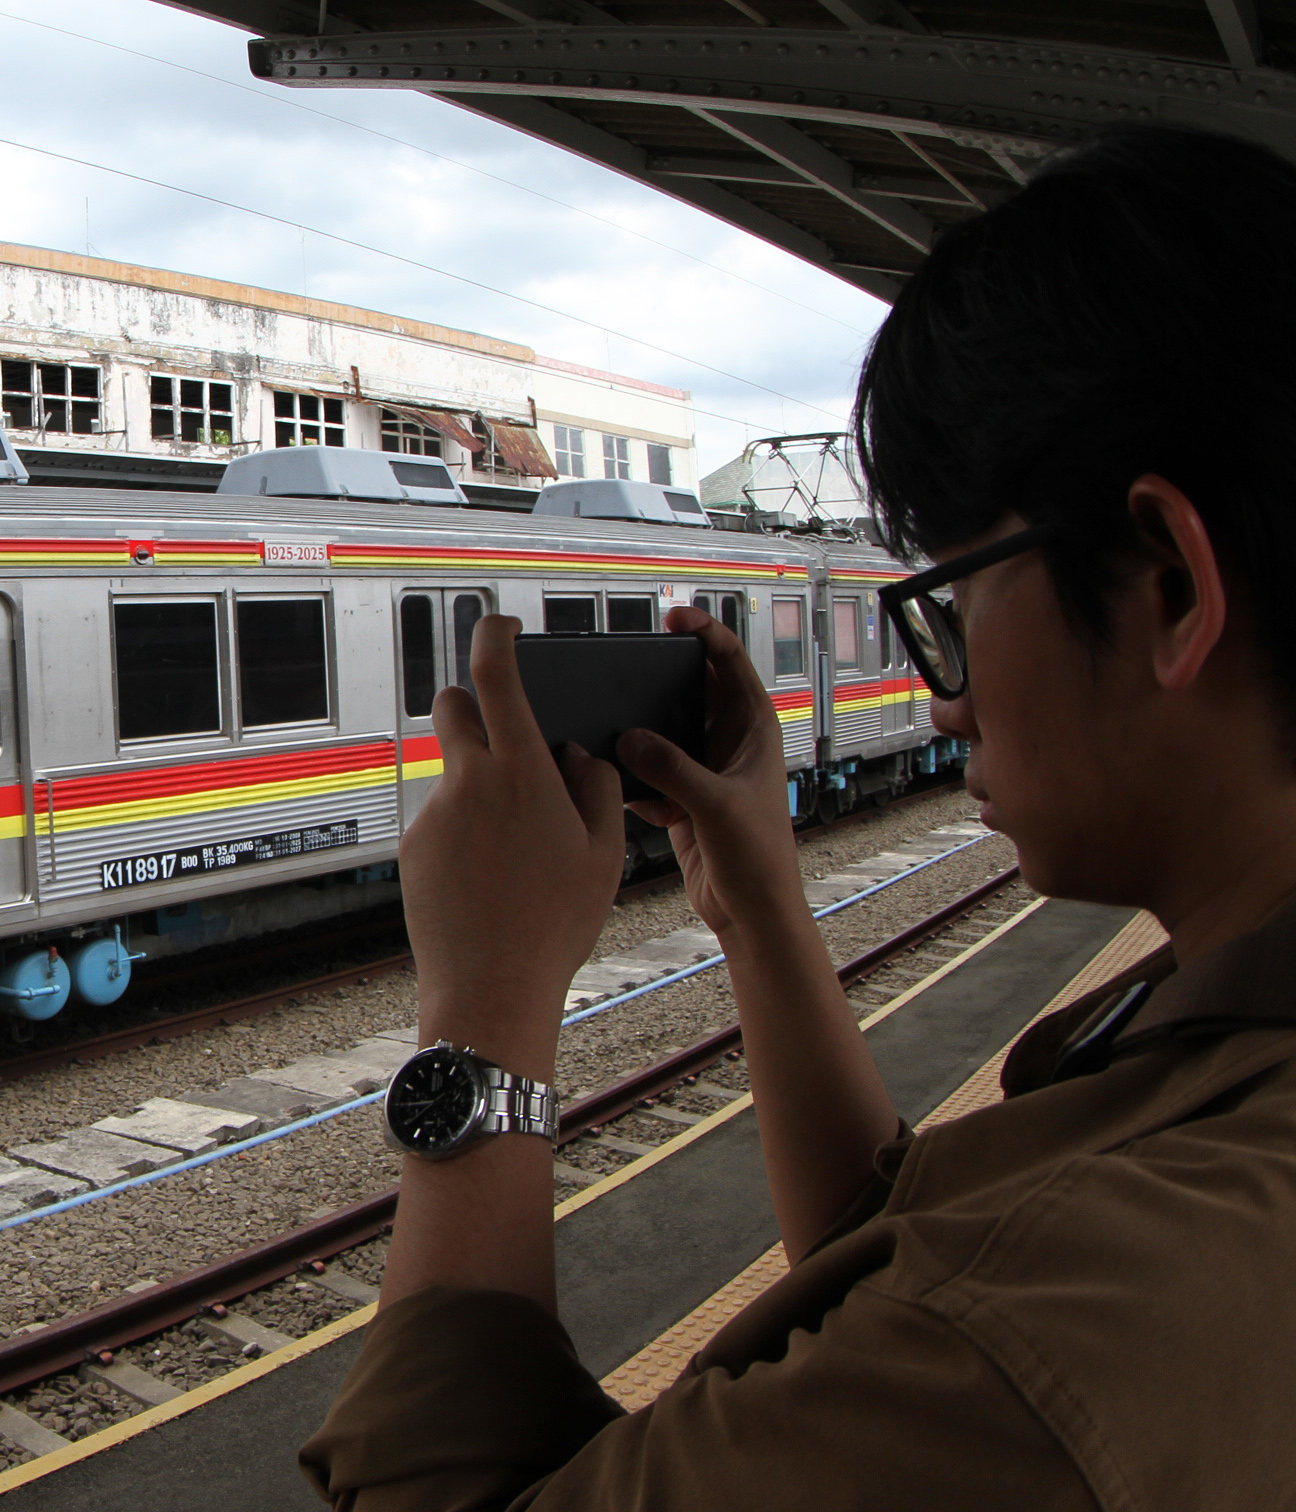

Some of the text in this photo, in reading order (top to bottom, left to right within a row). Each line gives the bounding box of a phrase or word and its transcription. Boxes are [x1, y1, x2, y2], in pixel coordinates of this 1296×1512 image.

[267, 546, 325, 560] 1925-2025
[659, 584, 674, 598] KAI
[103, 853, 177, 889] K118917
